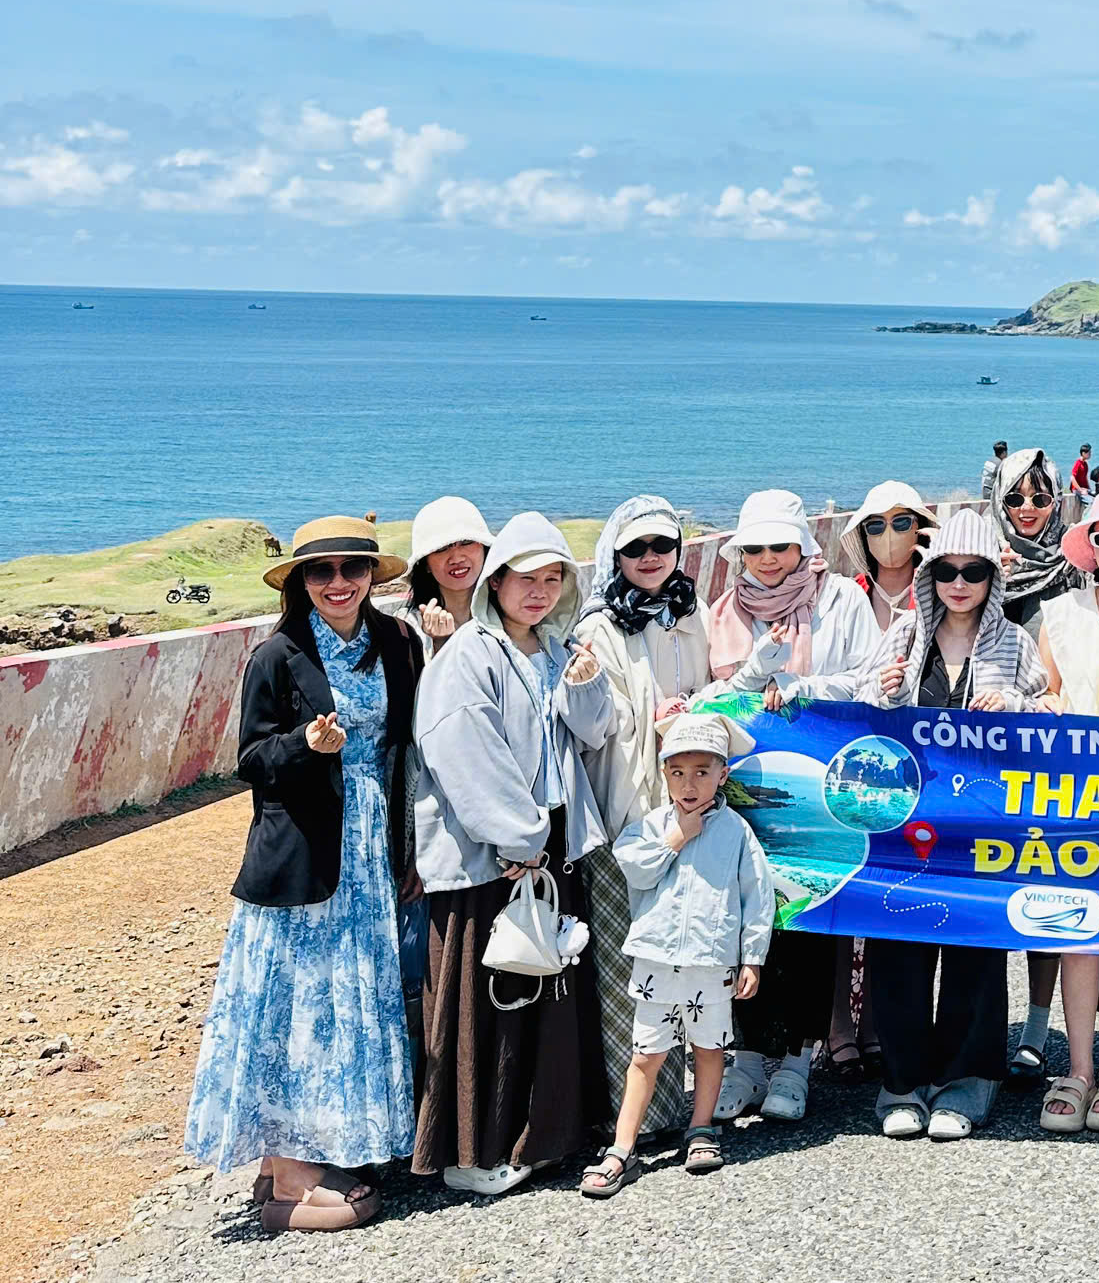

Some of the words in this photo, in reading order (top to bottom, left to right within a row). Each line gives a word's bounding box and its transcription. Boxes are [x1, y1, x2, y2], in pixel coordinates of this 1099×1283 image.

[912, 712, 1007, 751] CÔNG
[1017, 727, 1058, 753] TY
[1024, 892, 1089, 906] VINOTECH
